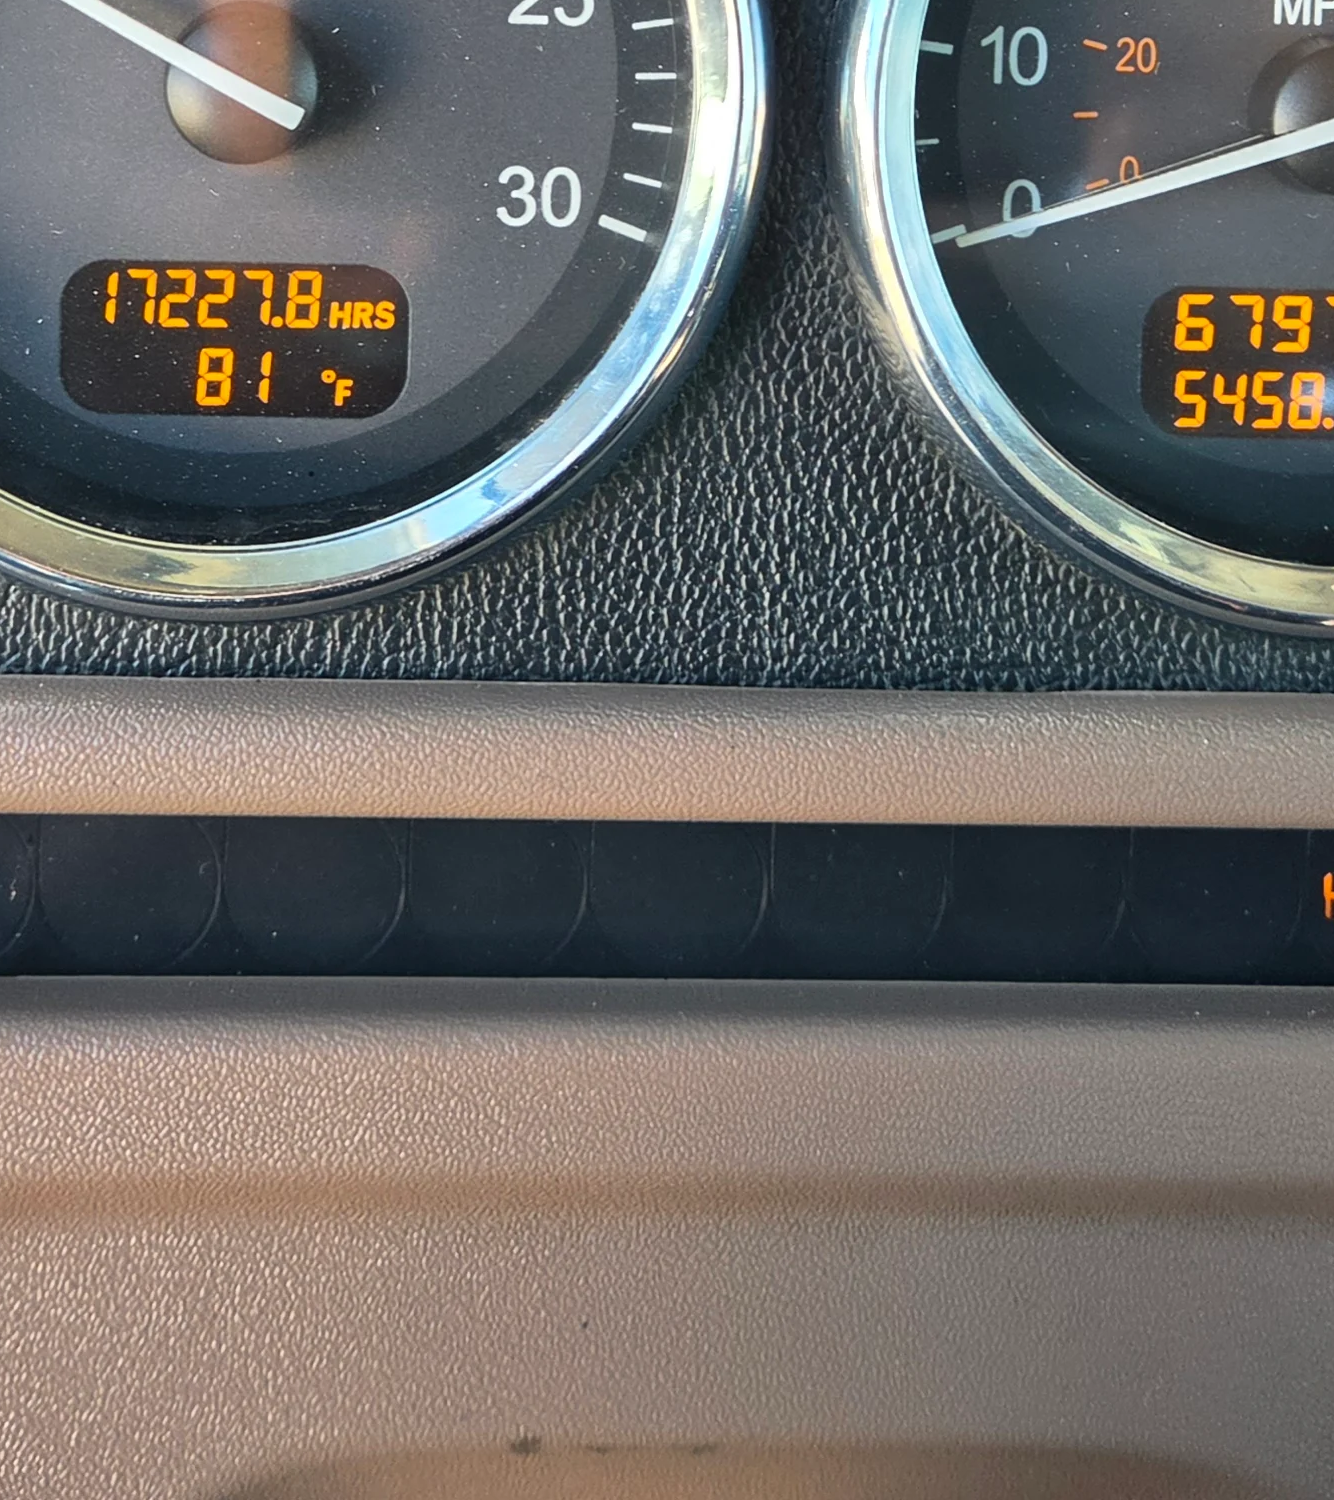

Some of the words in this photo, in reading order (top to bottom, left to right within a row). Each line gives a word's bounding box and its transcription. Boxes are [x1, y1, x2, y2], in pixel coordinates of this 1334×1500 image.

[980, 26, 1048, 86] 10
[1116, 37, 1157, 72] 20
[495, 166, 582, 227] 30
[1003, 178, 1042, 239] 0
[103, 267, 323, 329] 17227.8
[329, 298, 396, 330] HRS
[195, 346, 273, 406] 81
